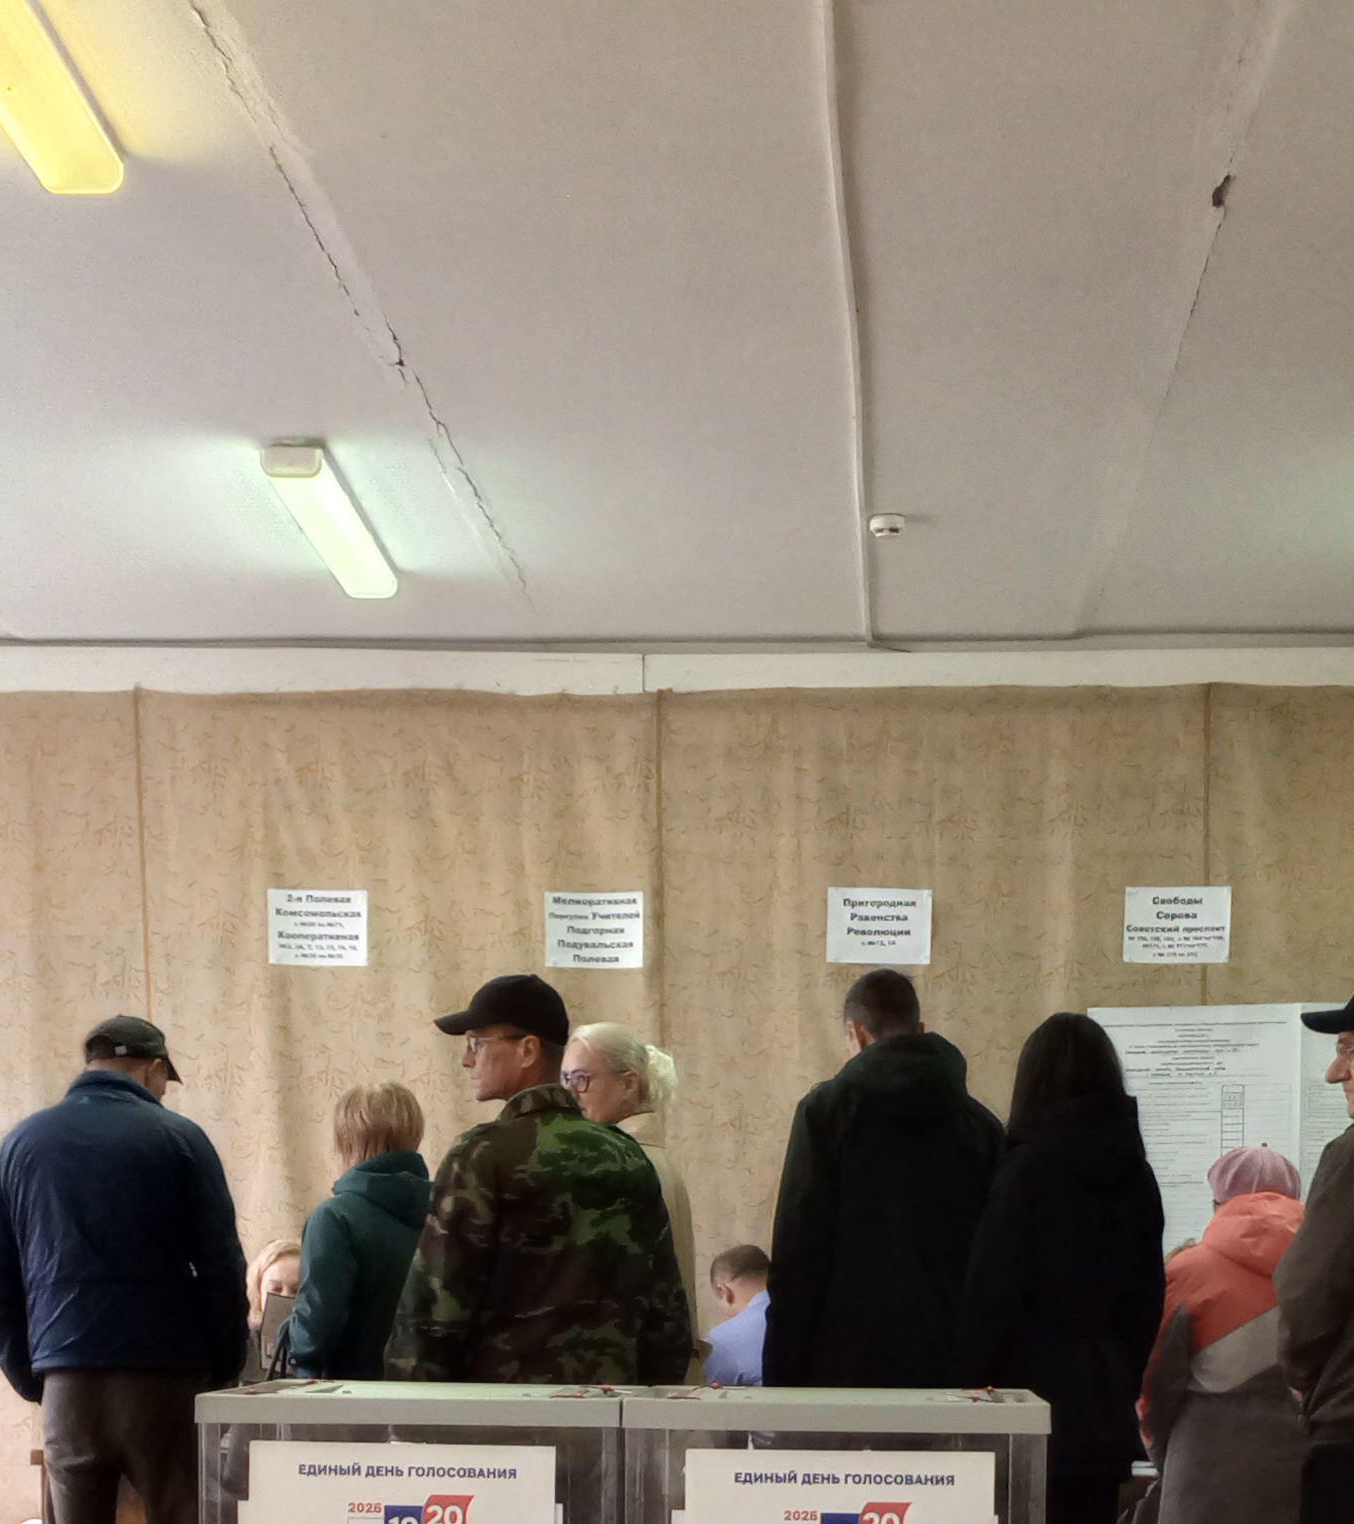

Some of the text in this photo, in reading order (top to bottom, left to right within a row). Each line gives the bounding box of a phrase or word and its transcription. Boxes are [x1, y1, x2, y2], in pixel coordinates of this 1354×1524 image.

[306, 895, 351, 903] Полевая
[553, 897, 637, 907] Мелиоративная
[843, 899, 916, 908] Пригородная
[1152, 896, 1203, 905] Свободы
[275, 908, 361, 917] Комсомольская
[850, 913, 908, 921] Равенства
[1156, 911, 1197, 921] Серова
[567, 926, 625, 935] Подгорная
[847, 927, 911, 936] Революции
[1126, 924, 1179, 933] Советский
[278, 931, 359, 941] Кооперативная
[573, 954, 619, 962] Полевая
[298, 1462, 517, 1479] ЕДИНЫЙ ДЕНЬ ГОЛОСОВАНИЯ
[734, 1470, 955, 1486] ЕДИНЫЙ ДЕНЬ ГОЛОСОВАНИЯ
[348, 1502, 382, 1513] 2026
[784, 1510, 818, 1521] 2026
